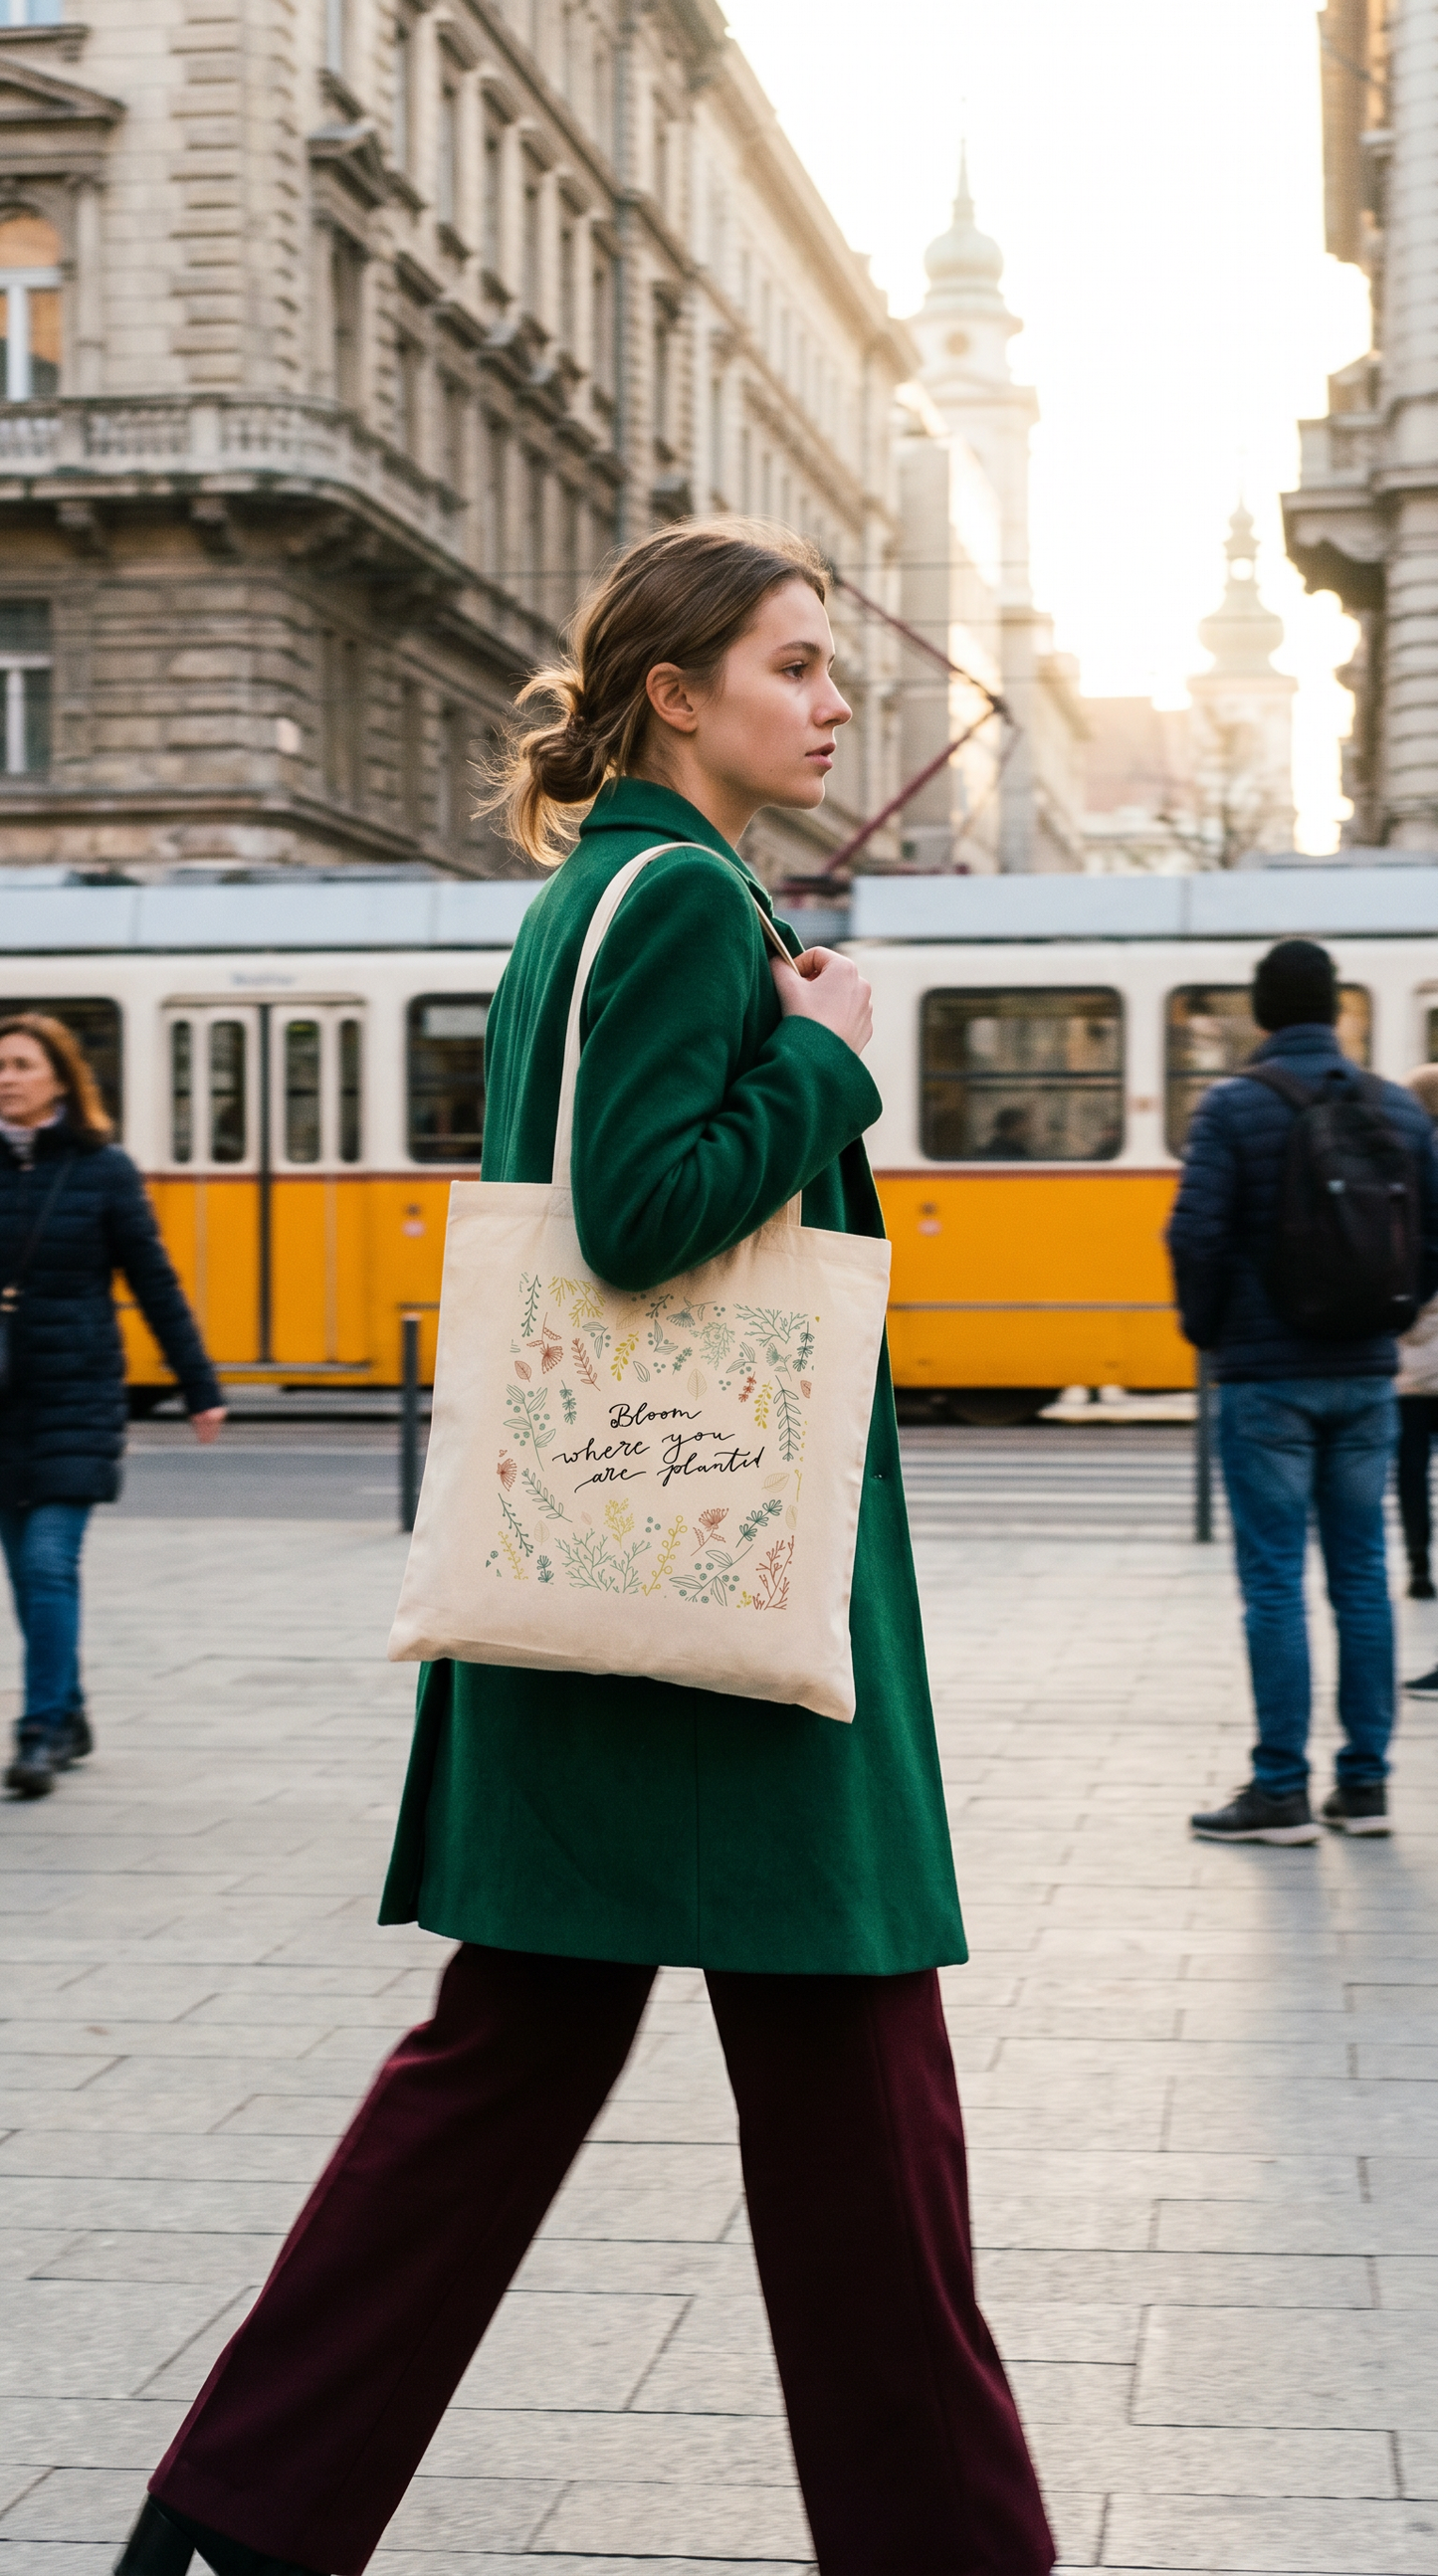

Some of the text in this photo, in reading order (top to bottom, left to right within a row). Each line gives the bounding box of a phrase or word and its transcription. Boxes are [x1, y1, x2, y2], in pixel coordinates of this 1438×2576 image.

[609, 1403, 703, 1428] Bloom
[552, 1431, 735, 1464] where you
[574, 1467, 647, 1493] are
